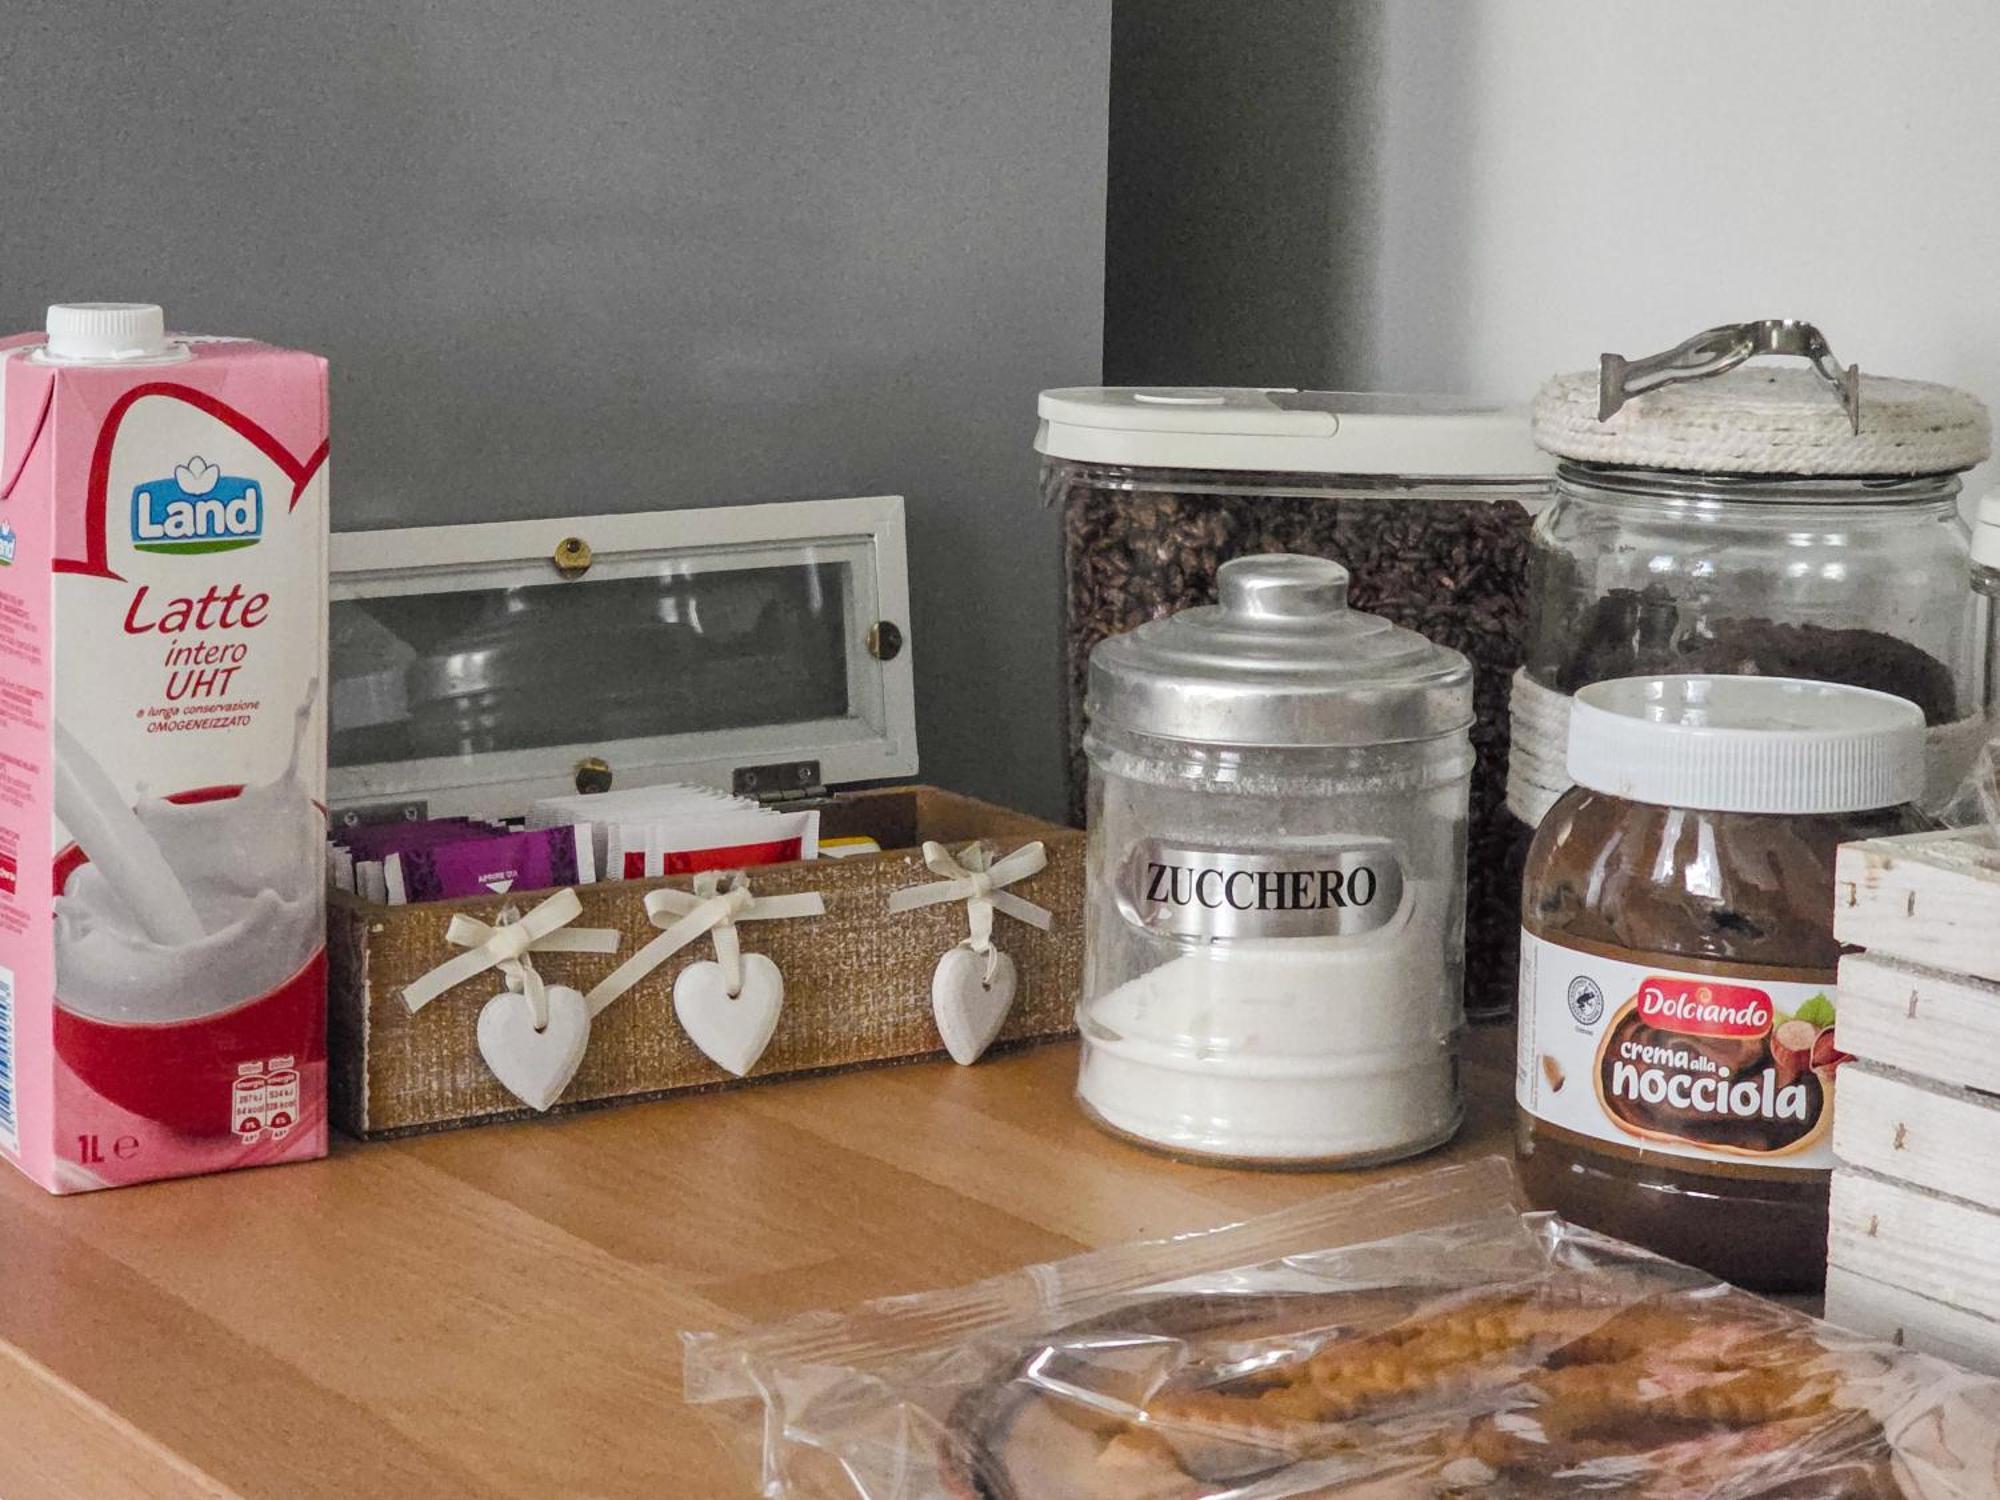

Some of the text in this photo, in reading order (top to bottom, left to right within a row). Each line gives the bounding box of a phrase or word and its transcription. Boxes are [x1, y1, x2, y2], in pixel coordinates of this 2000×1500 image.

[137, 487, 257, 539] Land
[124, 583, 270, 635] Latte
[164, 639, 248, 667] intero
[166, 666, 242, 700] UHT
[147, 706, 179, 720] lunga
[183, 700, 260, 715] conservazione
[147, 715, 251, 733] OMOGENEIZZATO
[1146, 862, 1376, 910] ZUCCHERO
[1641, 987, 1769, 1028] Dolciando
[1620, 1040, 1717, 1073] crema alla
[1612, 1060, 1807, 1120] nocciola
[79, 1135, 105, 1164] 1L
